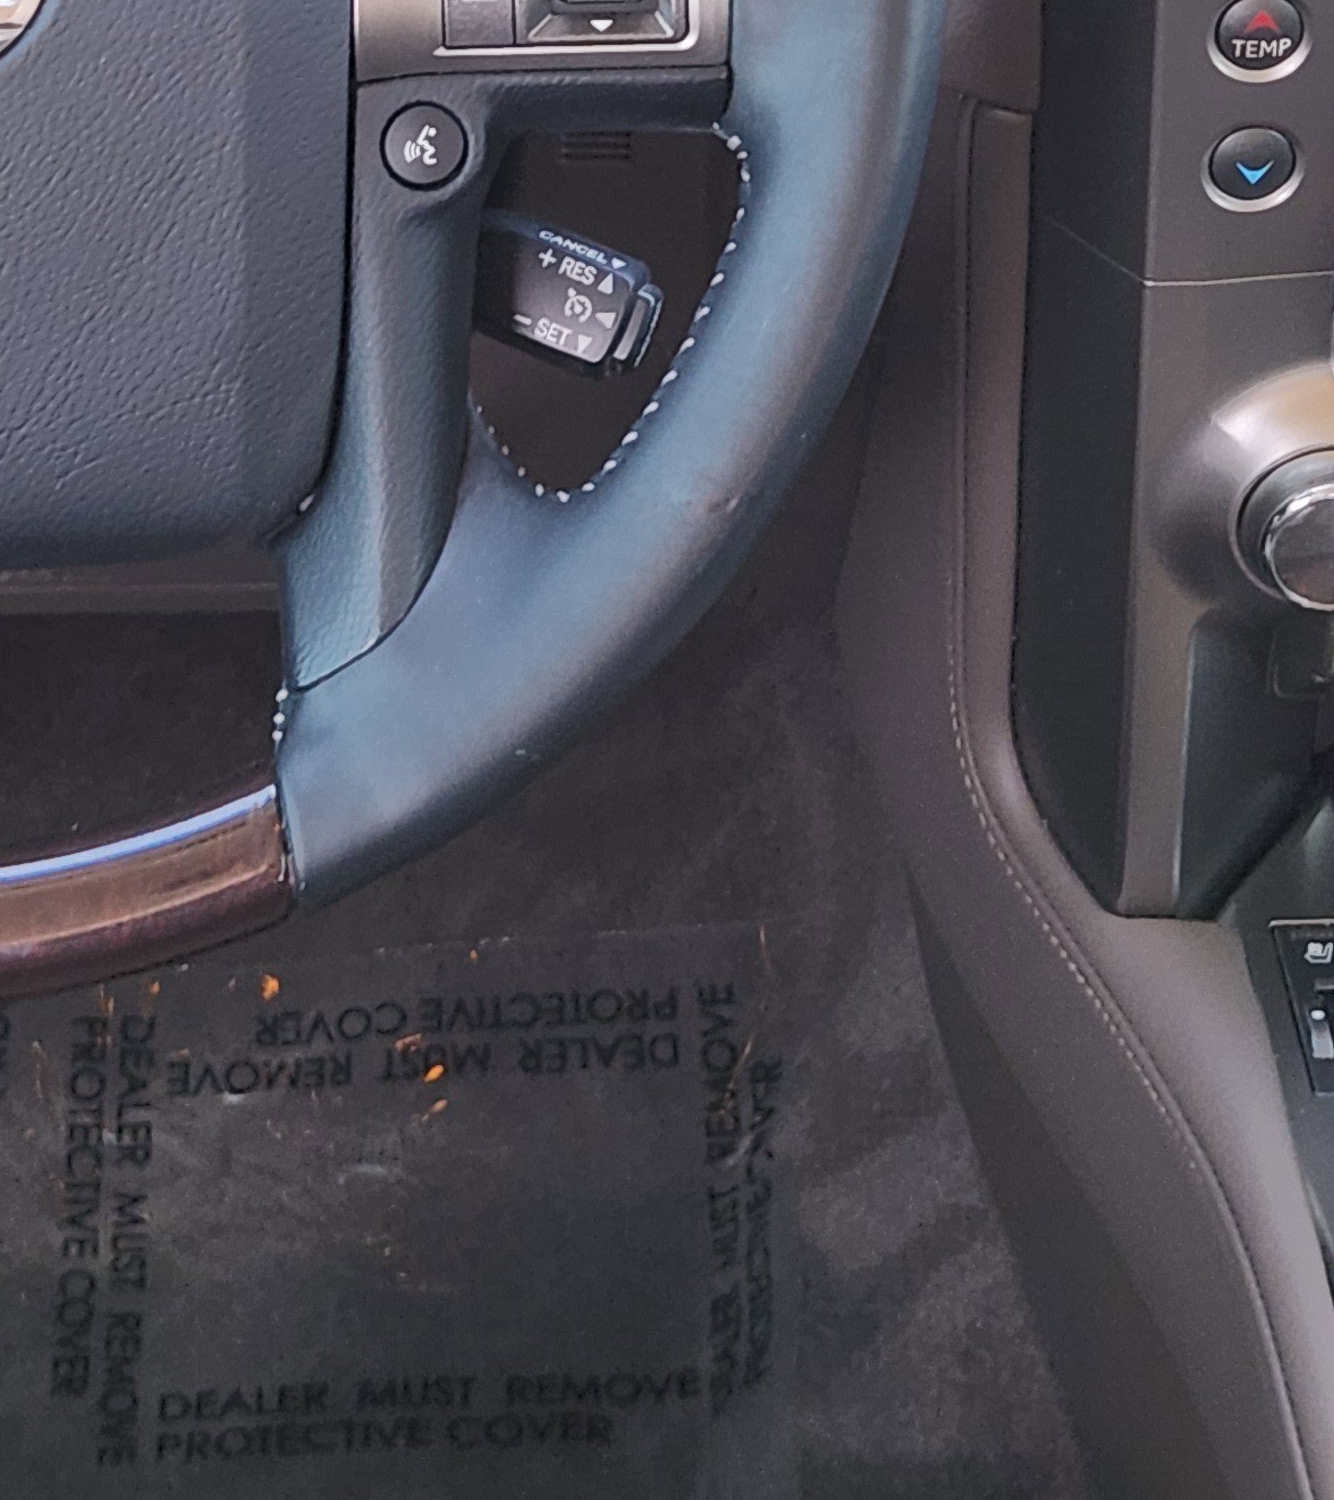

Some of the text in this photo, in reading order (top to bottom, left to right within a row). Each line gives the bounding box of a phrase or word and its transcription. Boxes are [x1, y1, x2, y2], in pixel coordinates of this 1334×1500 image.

[1232, 36, 1292, 59] TEMP
[539, 229, 607, 266] CANCEL
[558, 254, 597, 287] RES
[533, 317, 572, 347] SET
[255, 987, 678, 1045] PROTECTIVE COVER
[113, 1014, 156, 1171] DEALER
[166, 1033, 680, 1097] DEALER MUST REMOVE
[51, 1015, 108, 1398] PROTECTIVE COVER
[108, 1191, 148, 1294] MUST
[159, 1365, 702, 1421] DEALER MUST REMOVE
[156, 1414, 614, 1464] PROTECTIVE COVER
